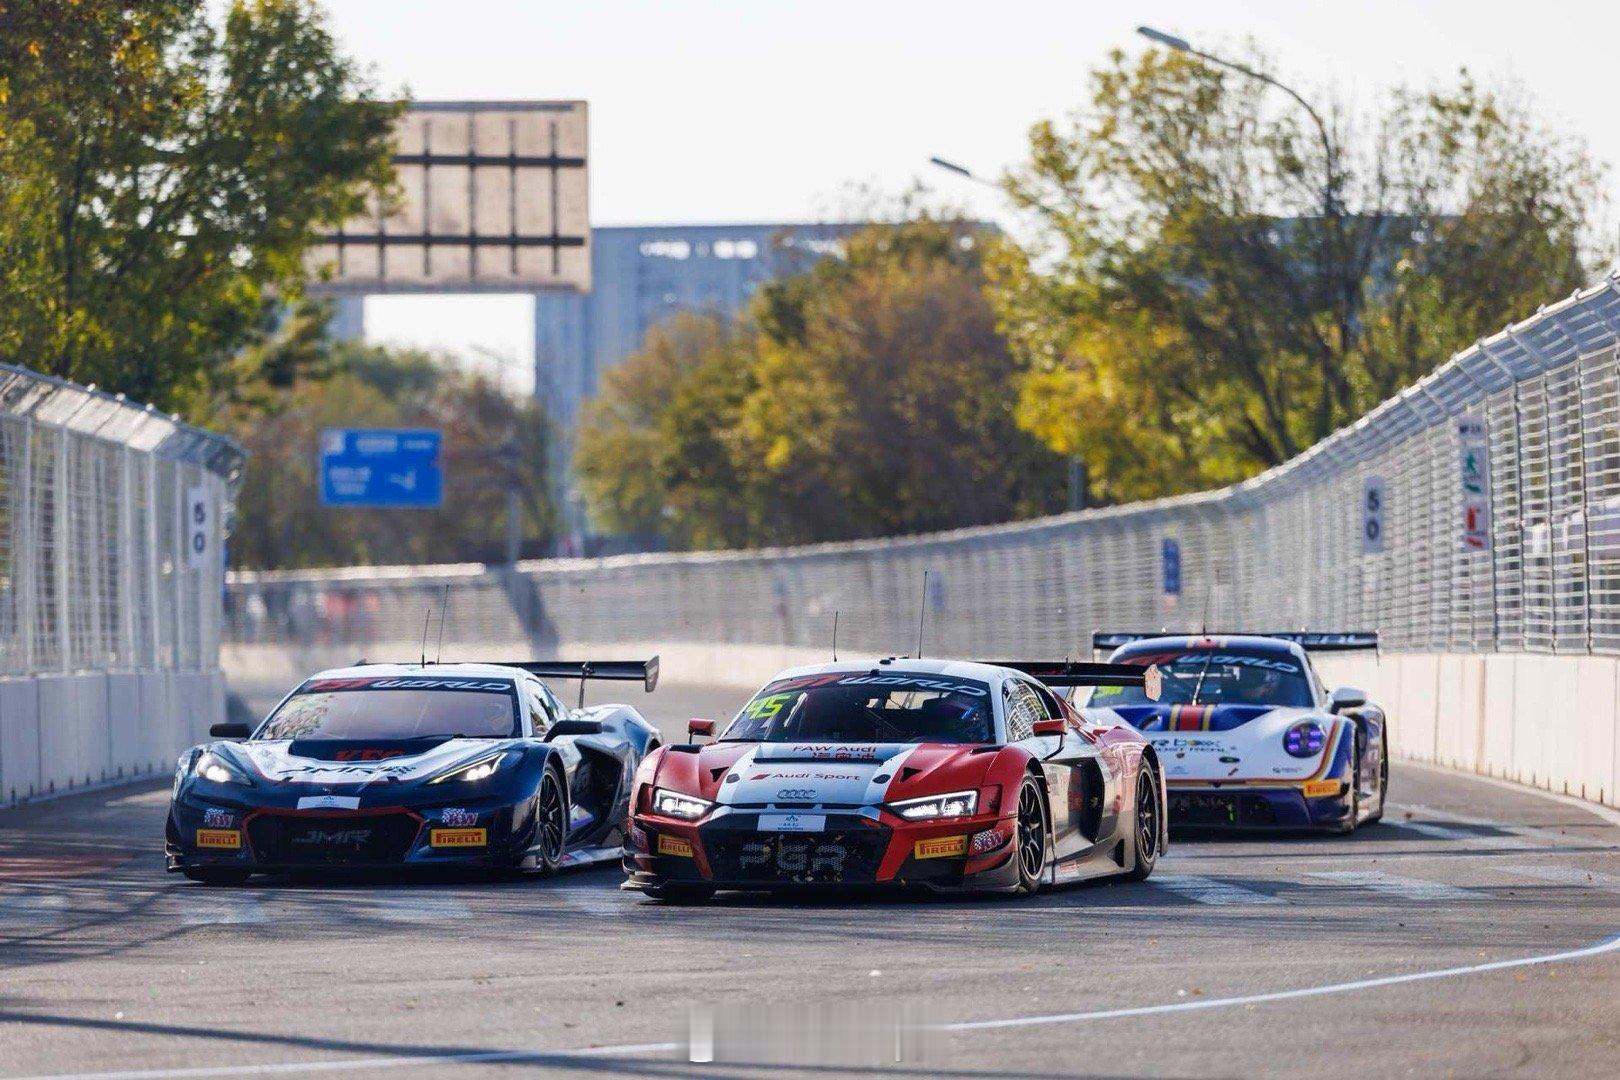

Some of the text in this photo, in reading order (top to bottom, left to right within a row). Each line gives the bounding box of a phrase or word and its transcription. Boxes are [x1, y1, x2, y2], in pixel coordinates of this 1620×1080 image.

[371, 679, 511, 691] WORLD
[836, 676, 988, 697] WORLD
[837, 745, 876, 753] Audi
[815, 773, 862, 782] Sport
[200, 832, 237, 844] PIRELLI
[435, 831, 482, 844] PIRELLI
[660, 837, 690, 853] PIRELLI
[919, 838, 964, 855] PIRELLI
